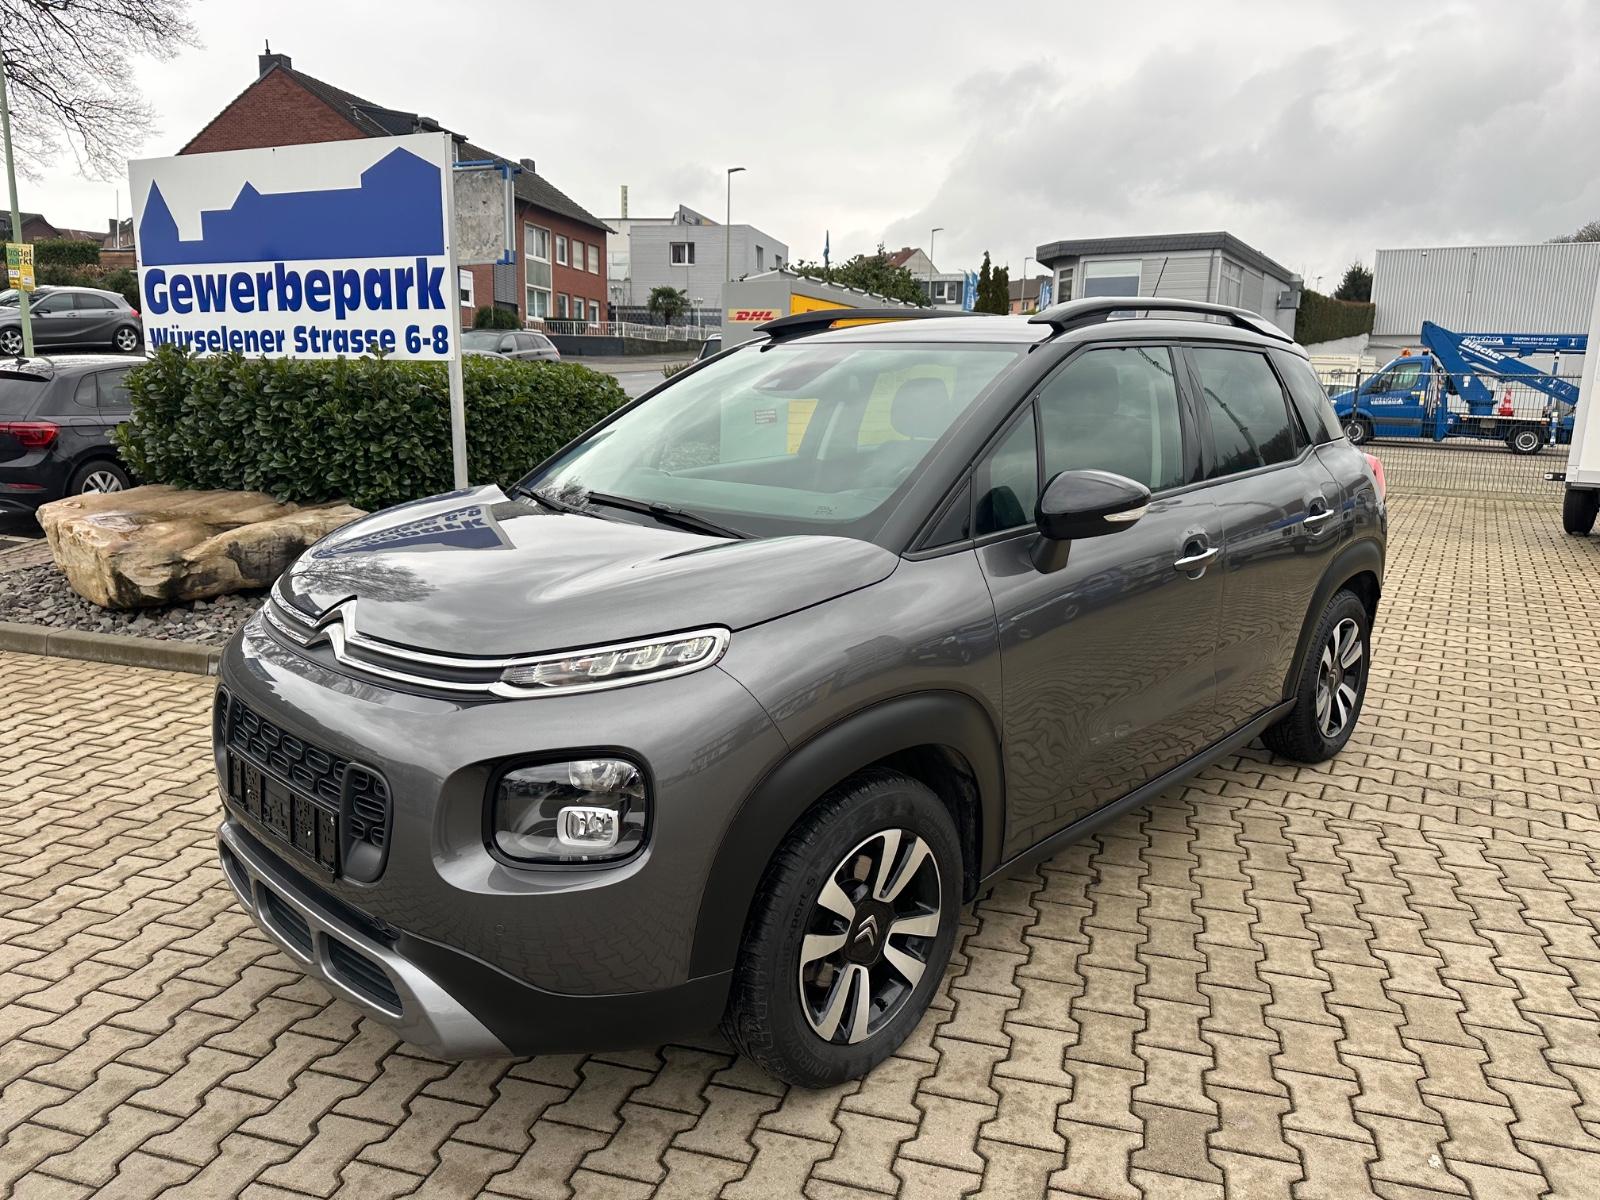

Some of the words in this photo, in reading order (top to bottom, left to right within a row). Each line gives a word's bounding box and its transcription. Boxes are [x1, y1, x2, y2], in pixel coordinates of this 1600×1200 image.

[144, 257, 446, 320] Gewerbepark
[735, 311, 774, 321] DHL
[149, 324, 285, 353] Würselener
[293, 325, 396, 353] Strasse
[405, 324, 449, 354] 6-8
